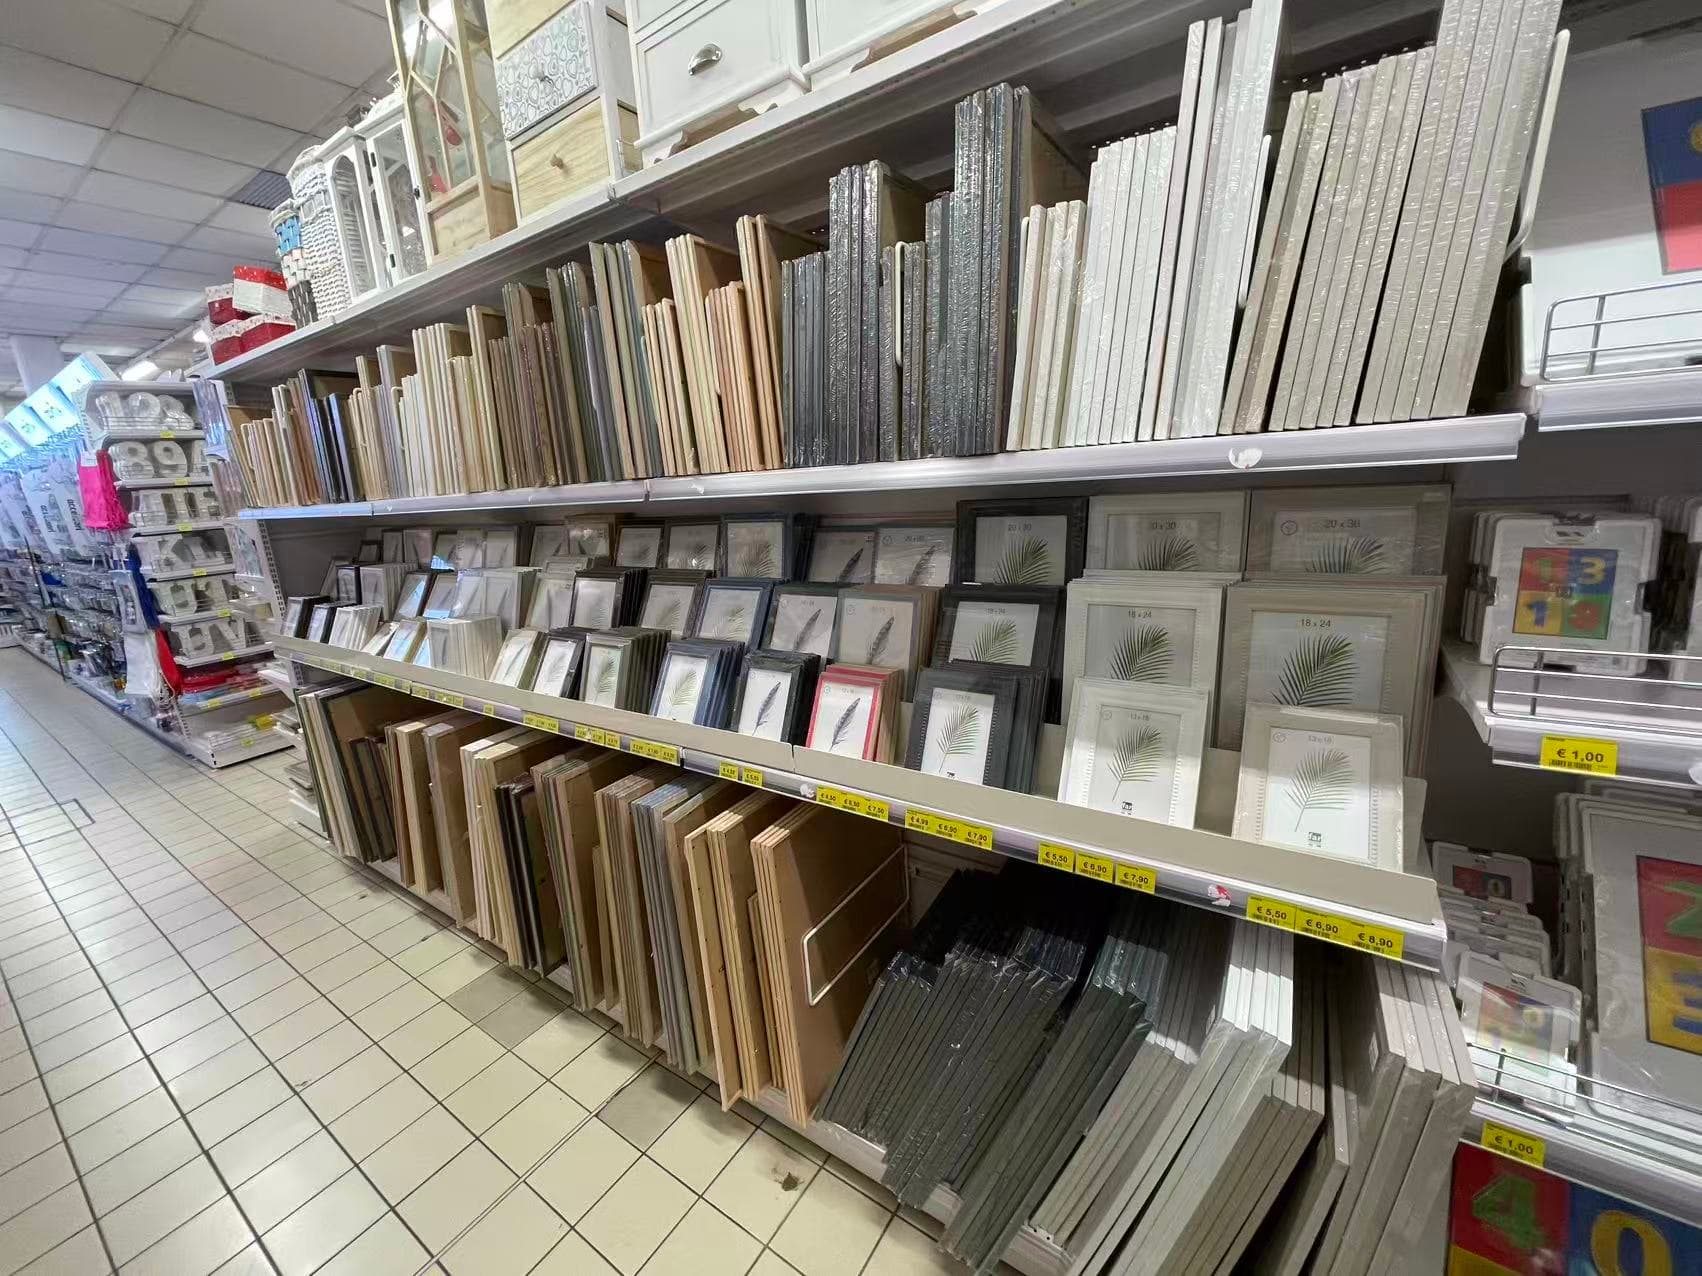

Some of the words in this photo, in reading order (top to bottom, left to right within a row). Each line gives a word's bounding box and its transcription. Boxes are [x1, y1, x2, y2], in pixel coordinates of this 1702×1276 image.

[1580, 556, 1607, 585] 3
[1142, 610, 1153, 619] 24
[1301, 618, 1312, 628] 18
[1319, 619, 1331, 629] 24
[1557, 748, 1567, 758] €
[1572, 750, 1604, 763] 1,00
[911, 816, 917, 824] €
[938, 823, 944, 831] €
[967, 831, 974, 839] €
[1045, 851, 1051, 859] €
[1052, 853, 1068, 863] 5,50
[1083, 861, 1089, 869] €
[1123, 872, 1130, 880] €
[1131, 873, 1149, 885] 7,90
[1256, 906, 1263, 914] €
[1265, 908, 1287, 920] 5,50
[1306, 919, 1313, 927] €
[1315, 921, 1339, 934] 6,90
[1358, 932, 1366, 941] €
[1368, 935, 1393, 948] 8,90
[1494, 1135, 1502, 1144] €
